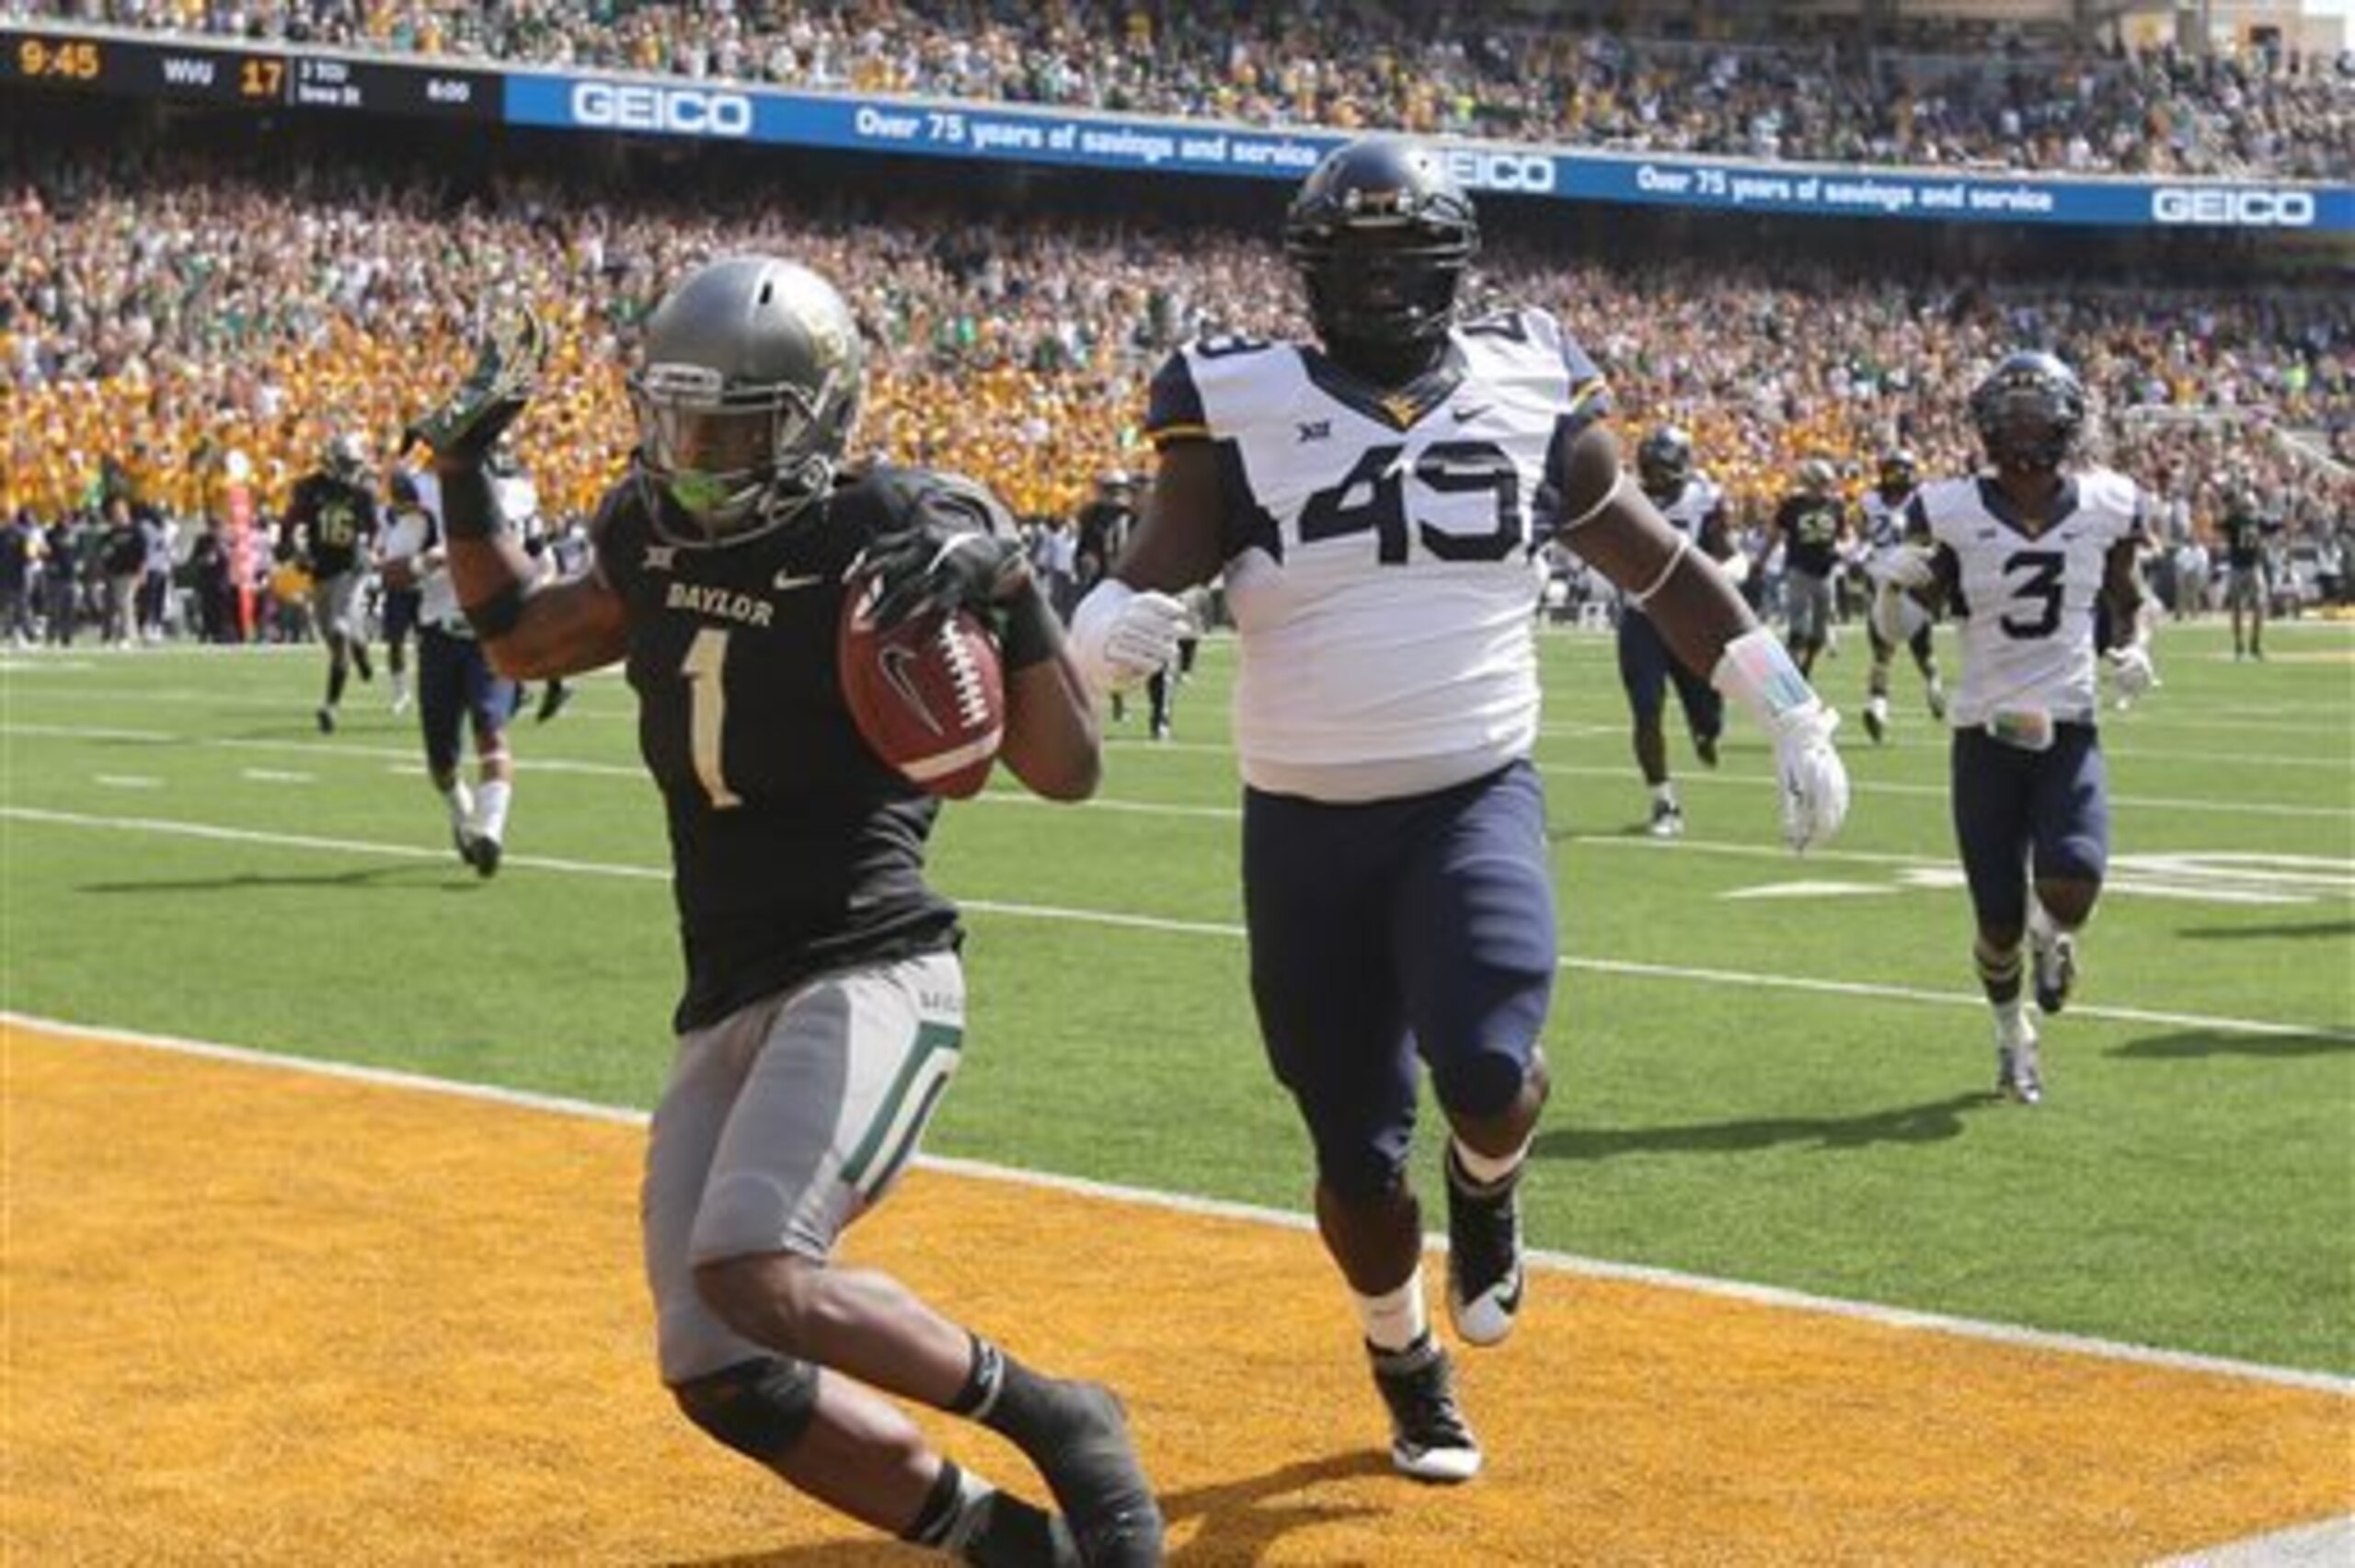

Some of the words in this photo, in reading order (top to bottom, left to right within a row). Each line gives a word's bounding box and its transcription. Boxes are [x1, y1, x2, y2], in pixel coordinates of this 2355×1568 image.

[19, 39, 100, 78] 9:45
[163, 57, 215, 86] WVU
[240, 58, 284, 97] 17
[572, 81, 753, 135] GEICO
[856, 107, 920, 138] Over
[926, 112, 967, 143] 75
[970, 122, 1042, 151] years
[1049, 122, 1077, 149] of
[1081, 128, 1175, 164] savings
[1180, 136, 1226, 162] and
[1231, 137, 1318, 166] service
[1437, 149, 1557, 192] EICO
[1636, 163, 1691, 193] Over
[1695, 169, 1727, 195] 75
[1731, 177, 1790, 203] years
[1797, 177, 1821, 200] of
[1825, 179, 1914, 213] savings
[1919, 184, 1966, 208] and
[1969, 184, 2054, 212] service
[2152, 189, 2315, 226] GEICO
[1298, 441, 1523, 565] 49
[666, 582, 775, 627] BAYLOR
[1999, 551, 2066, 640] 3
[680, 628, 743, 810] 1
